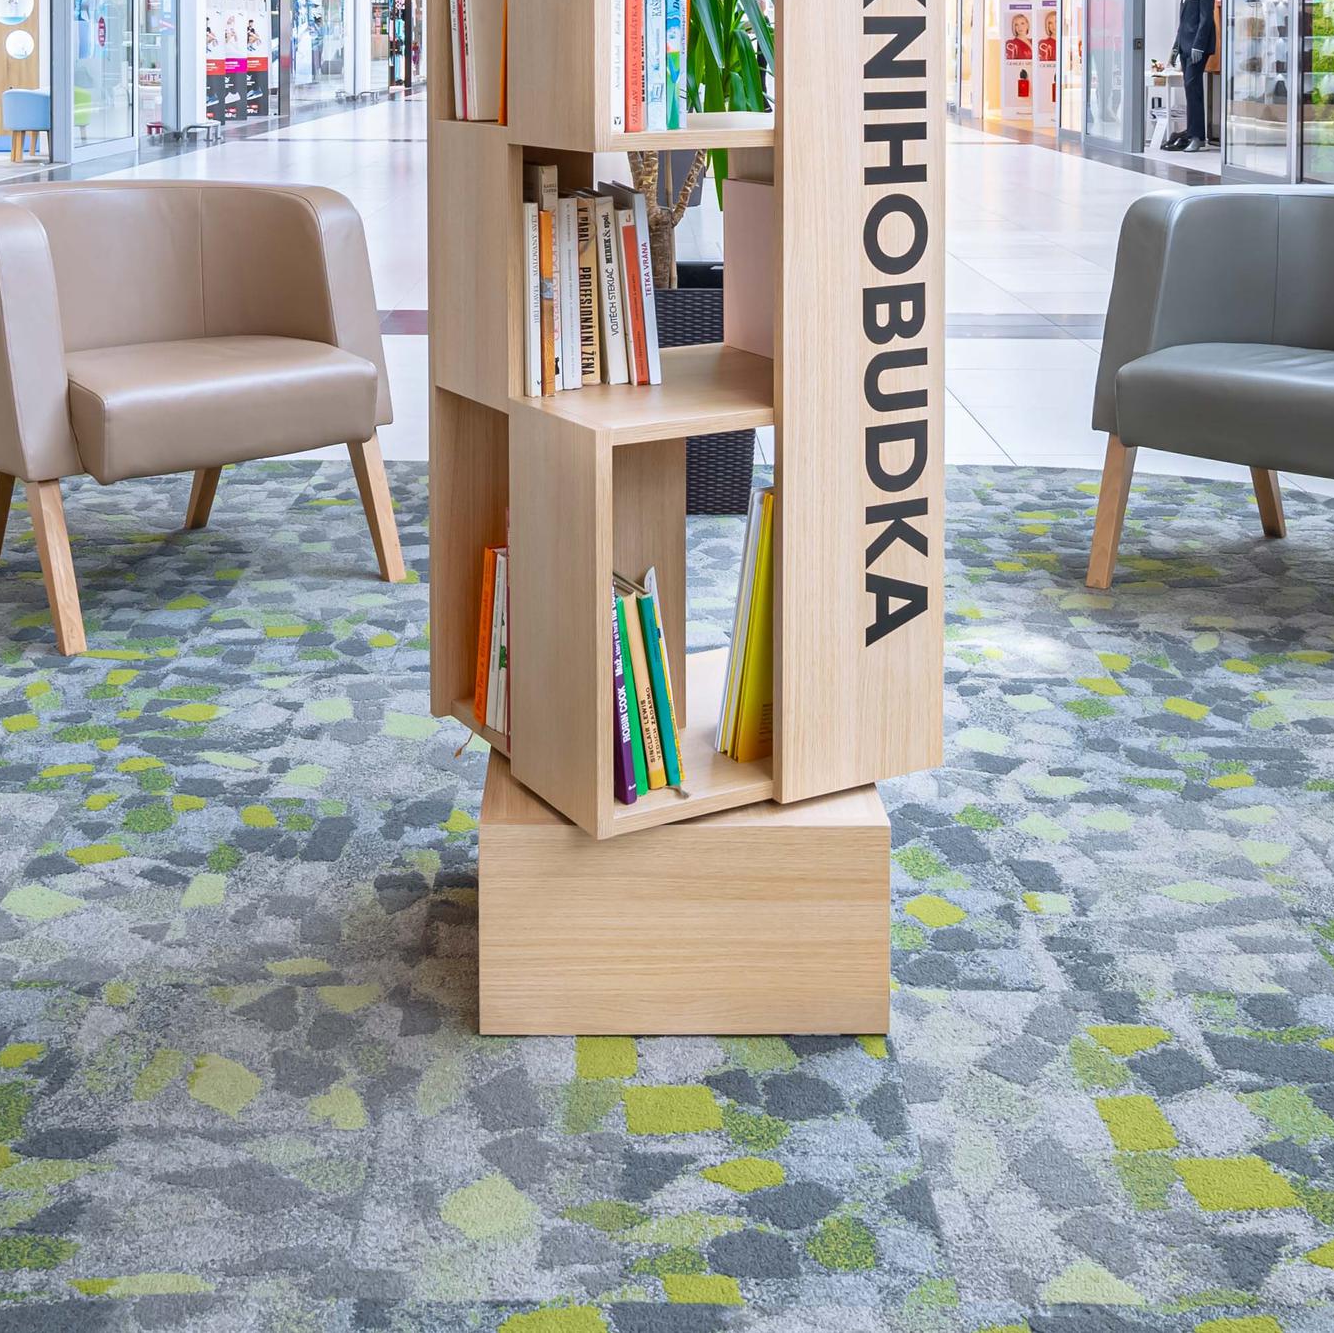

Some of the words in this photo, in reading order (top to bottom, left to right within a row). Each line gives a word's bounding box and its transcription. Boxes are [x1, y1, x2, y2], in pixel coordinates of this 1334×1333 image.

[605, 237, 613, 264] MIREK
[640, 242, 649, 270] VRÁNA
[607, 268, 617, 300] STEKLAČ
[644, 273, 652, 297] TETKA
[610, 301, 620, 337] VOJTĚCH
[618, 685, 628, 712] COOK
[640, 699, 650, 725] LEWIS
[646, 687, 656, 725] ZADARMO
[622, 713, 631, 743] ROBIN
[645, 726, 656, 763] SINCLAIR
[653, 728, 661, 761] VZDUCH
